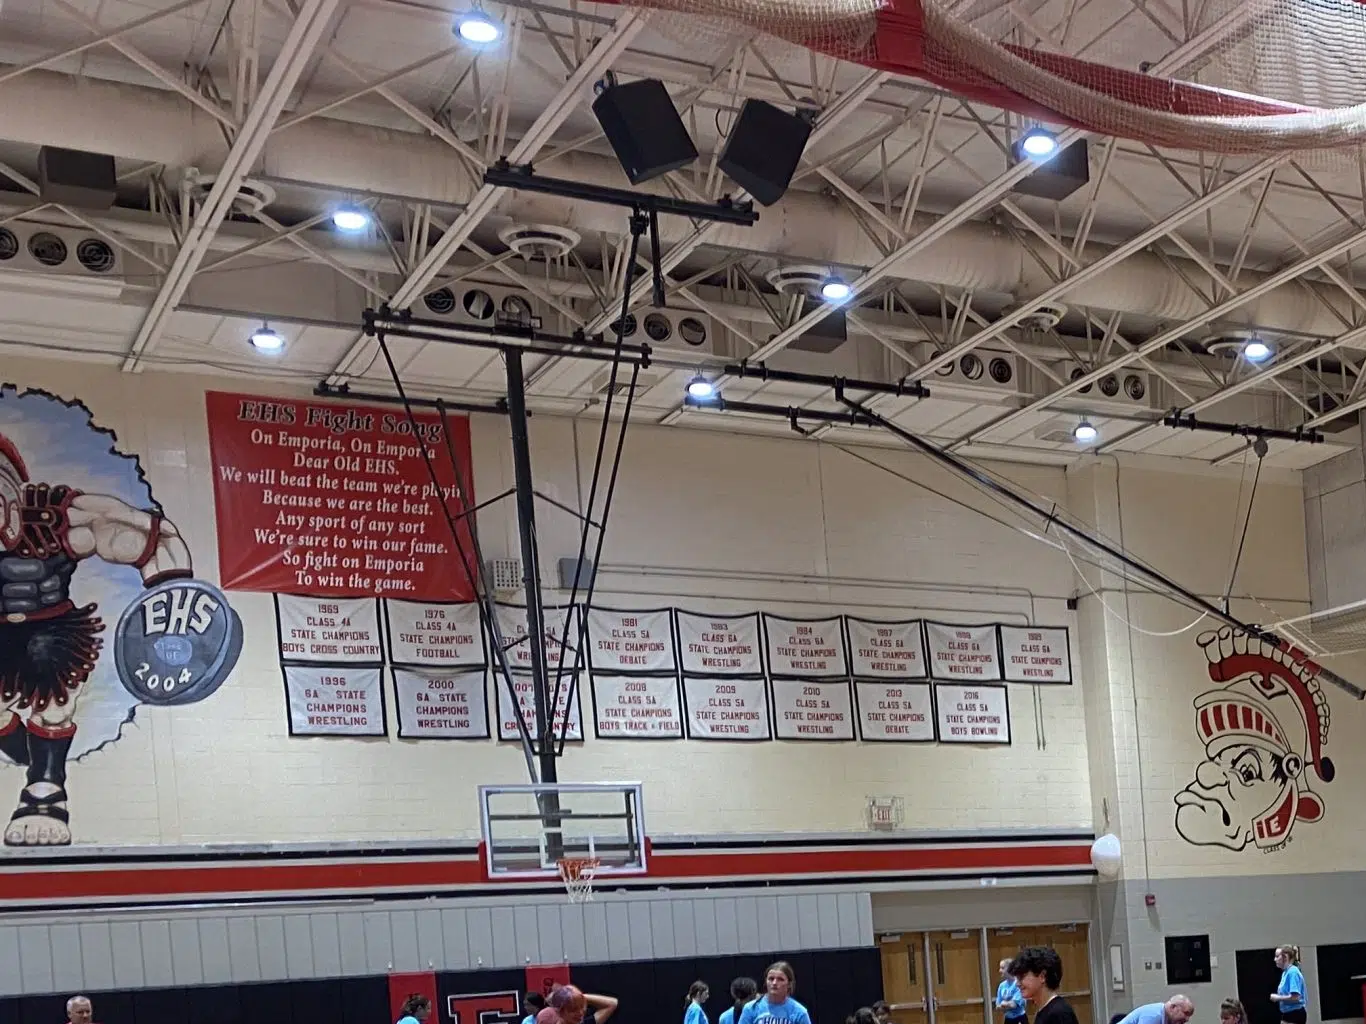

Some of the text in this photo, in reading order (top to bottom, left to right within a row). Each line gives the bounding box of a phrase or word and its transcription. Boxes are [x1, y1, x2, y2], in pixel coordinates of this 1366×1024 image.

[237, 400, 443, 444] EHS Fight Song
[251, 428, 372, 458] On Emporia, On
[294, 452, 400, 476] Dear Old EHS.
[219, 466, 418, 495] We will beat the team we're
[263, 489, 433, 516] Because we are the best.
[275, 510, 425, 536] Any sport of any sort
[254, 528, 448, 557] We're sure to win our fame.
[282, 550, 424, 575] So fight on Emporia
[295, 570, 416, 593] To win the game.
[142, 588, 219, 636] EHS
[318, 604, 339, 614] 1969
[425, 609, 445, 619] 1976
[306, 616, 335, 627] CLASS
[415, 621, 457, 631] CLASS 4A
[291, 629, 370, 641] STATE CHAMPIONS
[400, 633, 474, 645] STATE CHAMPIONS
[612, 629, 636, 639] CLASS
[701, 633, 724, 643] CLASS
[598, 640, 665, 652] STATE CHAMPIONS
[788, 636, 811, 646] CLASS
[870, 639, 892, 648] CLASS
[948, 641, 969, 651] CLASS
[282, 642, 380, 656] BOYS CROSS COUNTRY
[416, 648, 460, 659] FOOTBALL
[688, 644, 752, 655] STATE CHAMPIONS
[777, 647, 836, 658] STATE CHAMPIONS
[1021, 644, 1040, 654] CLASS
[858, 649, 916, 660] STATE CHAMPIONS
[936, 652, 993, 663] STATE CHAMPIONS
[620, 656, 647, 665] DEBATE
[702, 658, 741, 667] WRESTLING
[790, 661, 827, 670] WRESTLING
[1011, 655, 1062, 666] STATE CHAMPIONS
[871, 662, 907, 672] WRESTLING
[948, 665, 983, 675] WRESTLING
[134, 662, 192, 692] 2004
[1022, 669, 1054, 678] WRESTLING
[320, 676, 346, 686] 1996
[428, 680, 454, 689] 2000
[305, 689, 366, 699] 6A STATE
[715, 684, 736, 694] 2009
[803, 686, 821, 696] 2010
[886, 689, 903, 698] 2013
[416, 693, 467, 702] 6A STATE
[618, 695, 642, 705] CLASS
[964, 691, 979, 700] 2016
[708, 698, 731, 707] CLASS
[796, 698, 818, 708] CLASS
[878, 701, 900, 710] CLASS
[956, 703, 977, 712] CLASS
[306, 703, 367, 713] CHAMPIONS
[416, 706, 469, 715] CHAMPIONS
[605, 708, 672, 718] STATE CHAMPIONS
[307, 715, 368, 726] WRESTLING
[696, 711, 760, 721] STATE CHAMPIONS
[784, 711, 844, 722] STATE CHAMPIONS
[867, 712, 925, 722] STATE CHAMPIONS
[946, 715, 1001, 725] STATE CHAMPIONS
[417, 719, 470, 729] WRESTLING
[600, 721, 679, 731] BOYS TRACK FIELD
[709, 724, 749, 734] WRESTLING
[797, 725, 834, 734] WRESTLING
[885, 726, 910, 735] DEBATE
[950, 727, 998, 737] BOYS BOWLING
